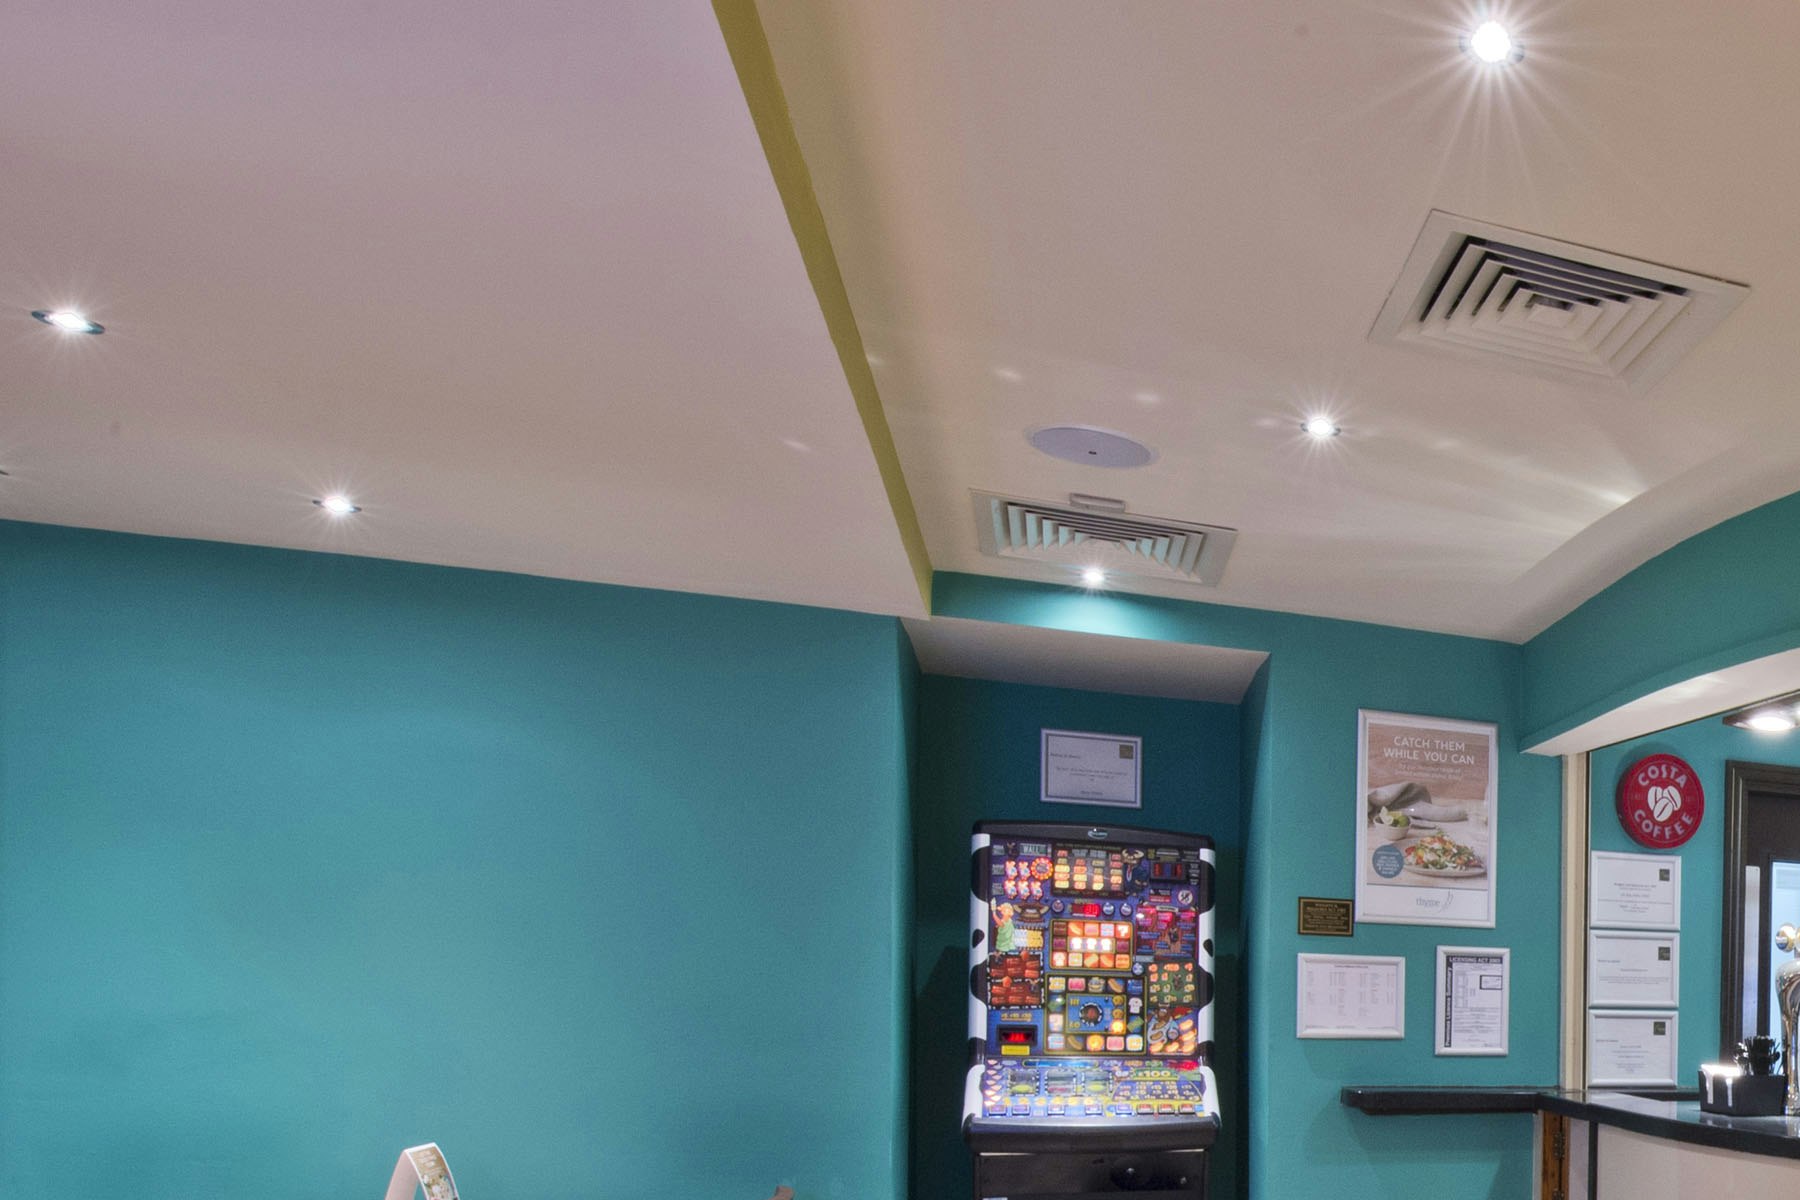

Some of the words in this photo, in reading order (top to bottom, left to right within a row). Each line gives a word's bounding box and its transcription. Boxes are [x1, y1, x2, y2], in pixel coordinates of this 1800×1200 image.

[1393, 736, 1430, 748] CATCH
[1433, 739, 1465, 752] THEM
[1383, 747, 1419, 760] WHILE
[1424, 751, 1448, 762] YOU
[1451, 754, 1475, 765] CAN
[1637, 764, 1688, 789] COSTA
[1634, 809, 1693, 840] COFFEE
